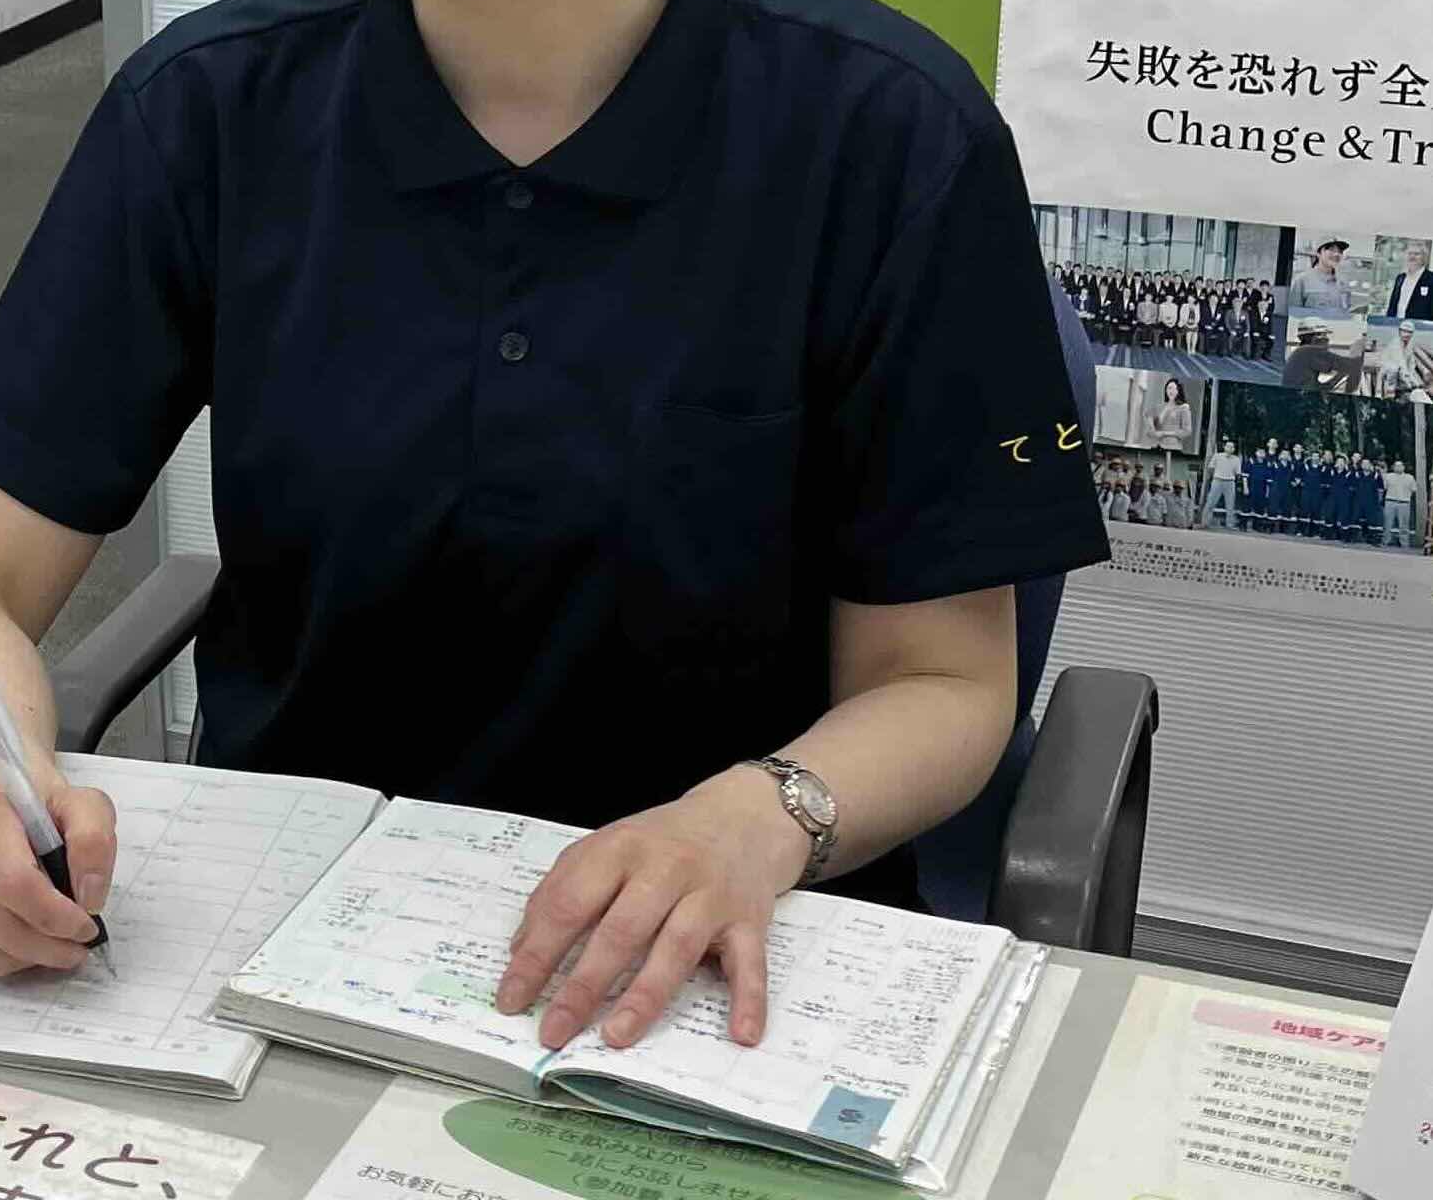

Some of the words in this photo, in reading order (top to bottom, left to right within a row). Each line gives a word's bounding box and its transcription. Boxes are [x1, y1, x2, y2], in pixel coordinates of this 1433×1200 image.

[1086, 40, 1433, 111] 失敗を恐れず全
[1146, 109, 1326, 164] Change
[357, 1164, 508, 1200] お気軽にお
[542, 1150, 773, 1200] 一緒にお話しませ
